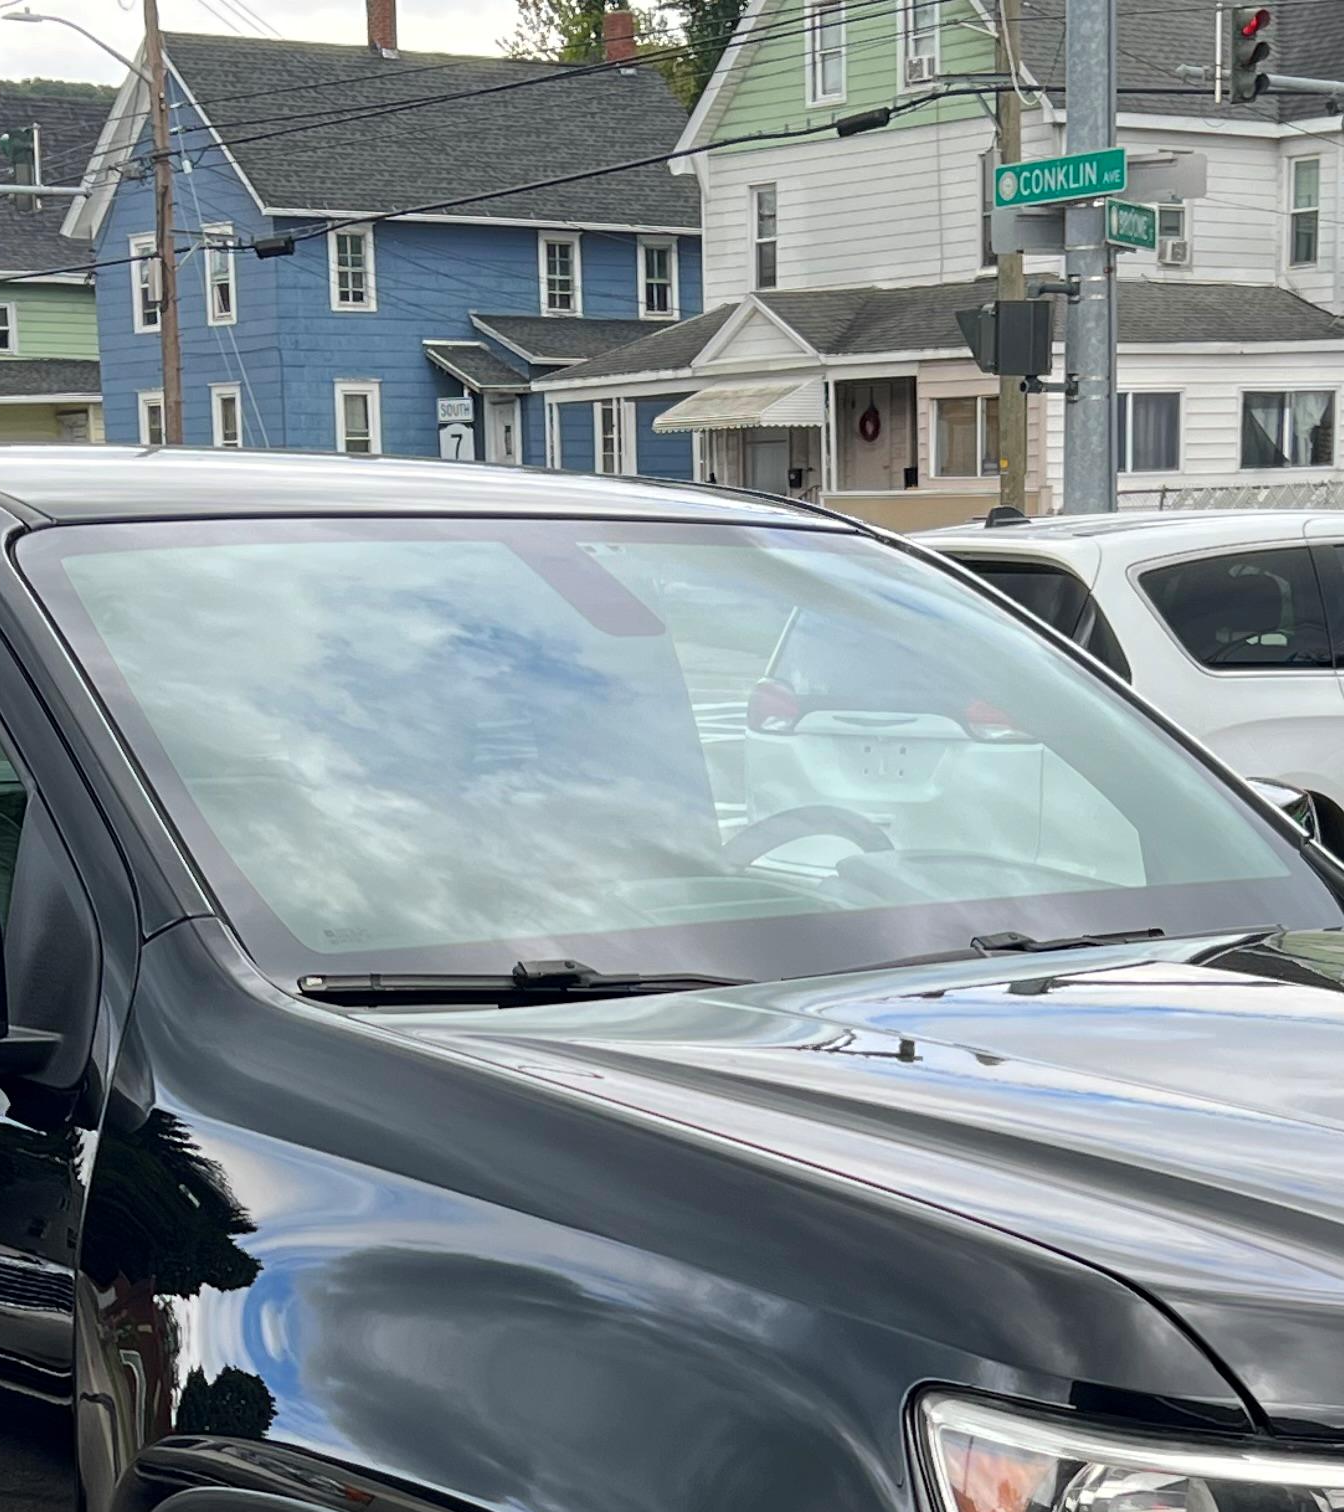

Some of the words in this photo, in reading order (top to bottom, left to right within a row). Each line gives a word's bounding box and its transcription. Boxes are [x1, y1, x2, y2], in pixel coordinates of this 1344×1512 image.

[1019, 161, 1098, 196] CONKLIN
[1102, 169, 1121, 184] AVE
[440, 403, 471, 418] SOUTH
[450, 433, 463, 461] 7
